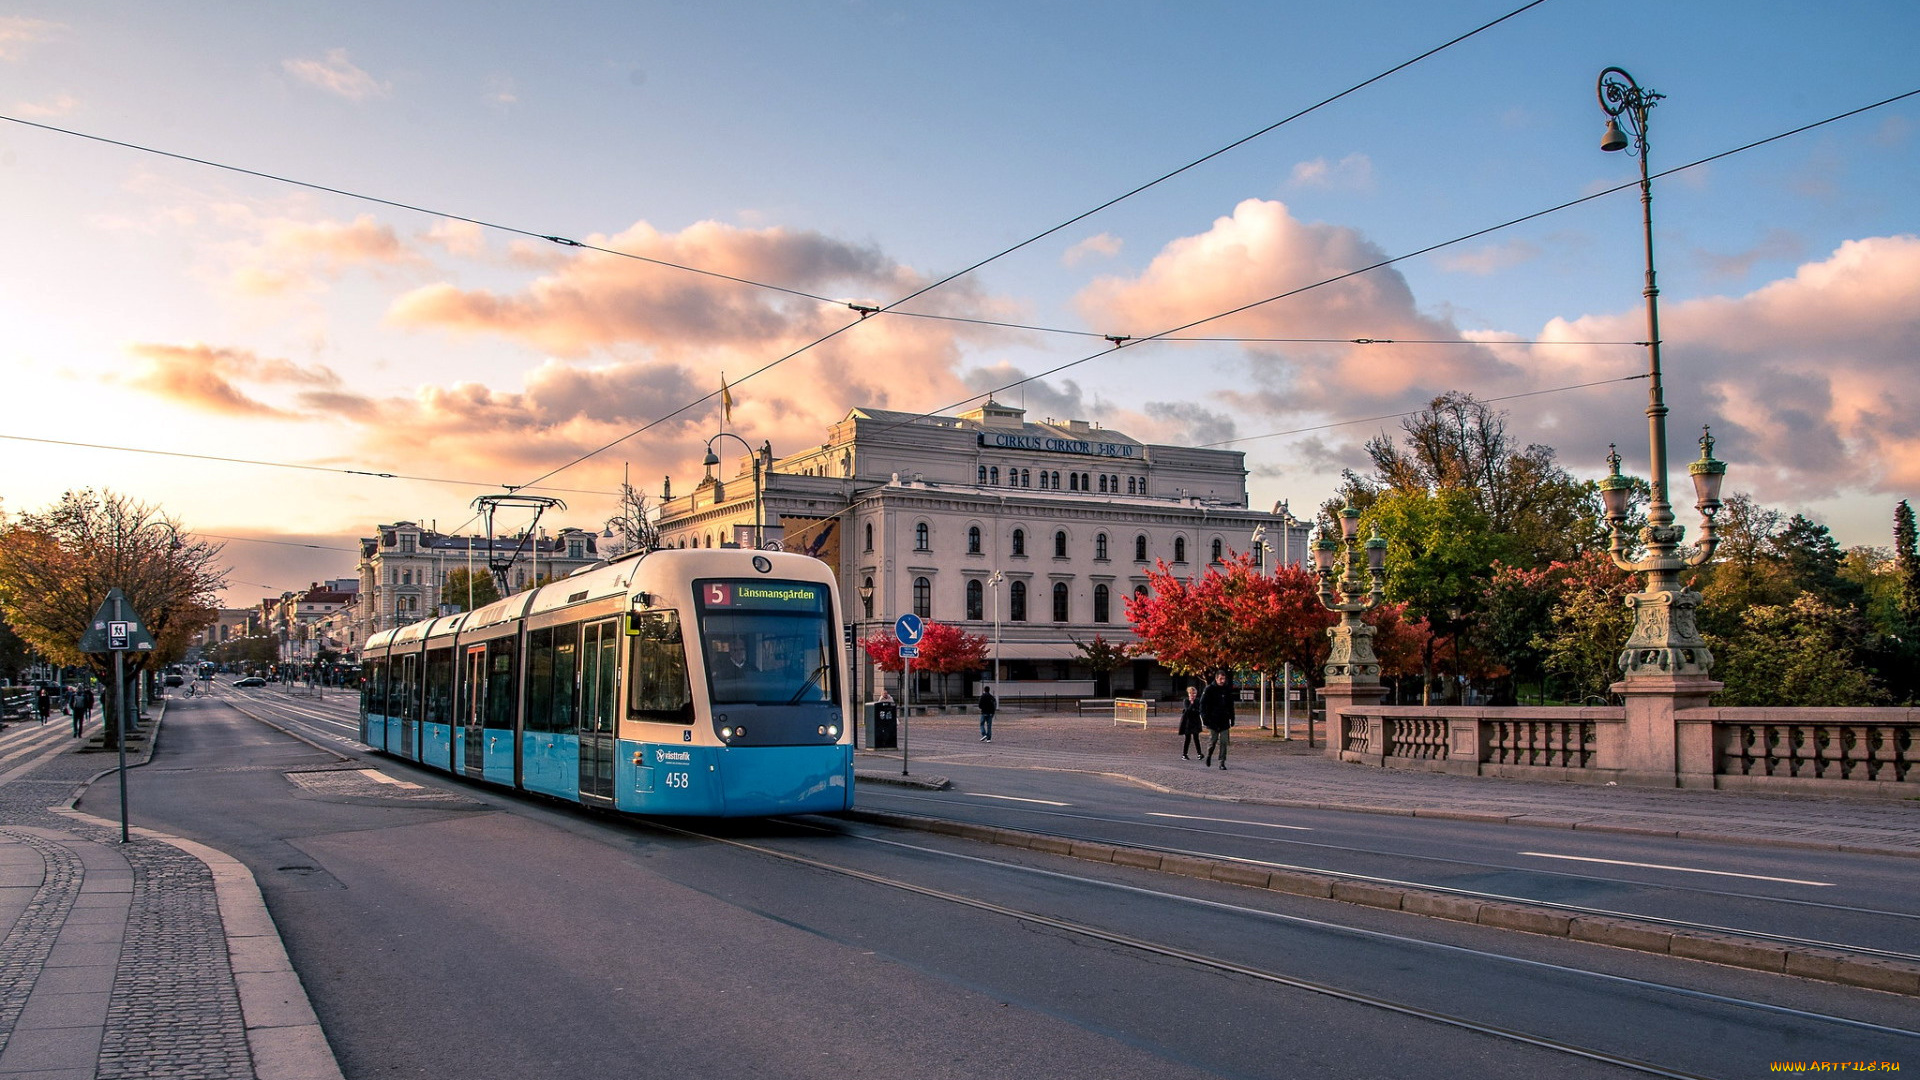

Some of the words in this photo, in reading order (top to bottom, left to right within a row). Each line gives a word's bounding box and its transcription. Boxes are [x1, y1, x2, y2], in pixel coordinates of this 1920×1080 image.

[996, 435, 1041, 449] CIRKUS
[1098, 443, 1133, 457] 3-18/10
[711, 584, 724, 604] 5
[738, 587, 814, 601] Länsmansgården
[665, 751, 690, 761] västtrafik
[665, 772, 689, 788] 458
